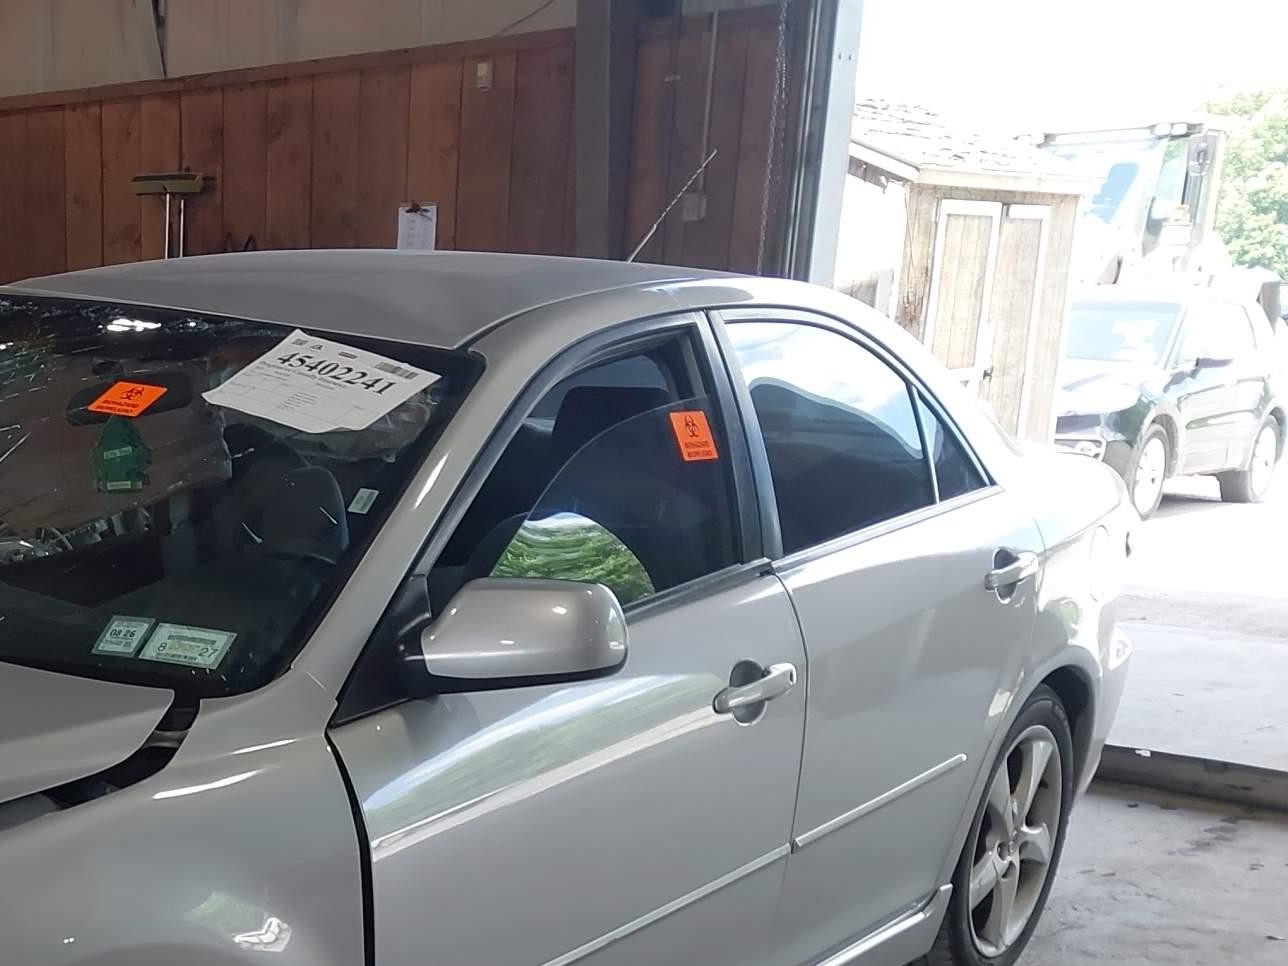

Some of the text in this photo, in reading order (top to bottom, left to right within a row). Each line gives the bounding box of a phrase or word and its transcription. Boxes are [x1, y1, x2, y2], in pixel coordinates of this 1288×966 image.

[277, 352, 397, 395] 45402241
[157, 642, 168, 652] 8
[198, 647, 218, 658] 27
